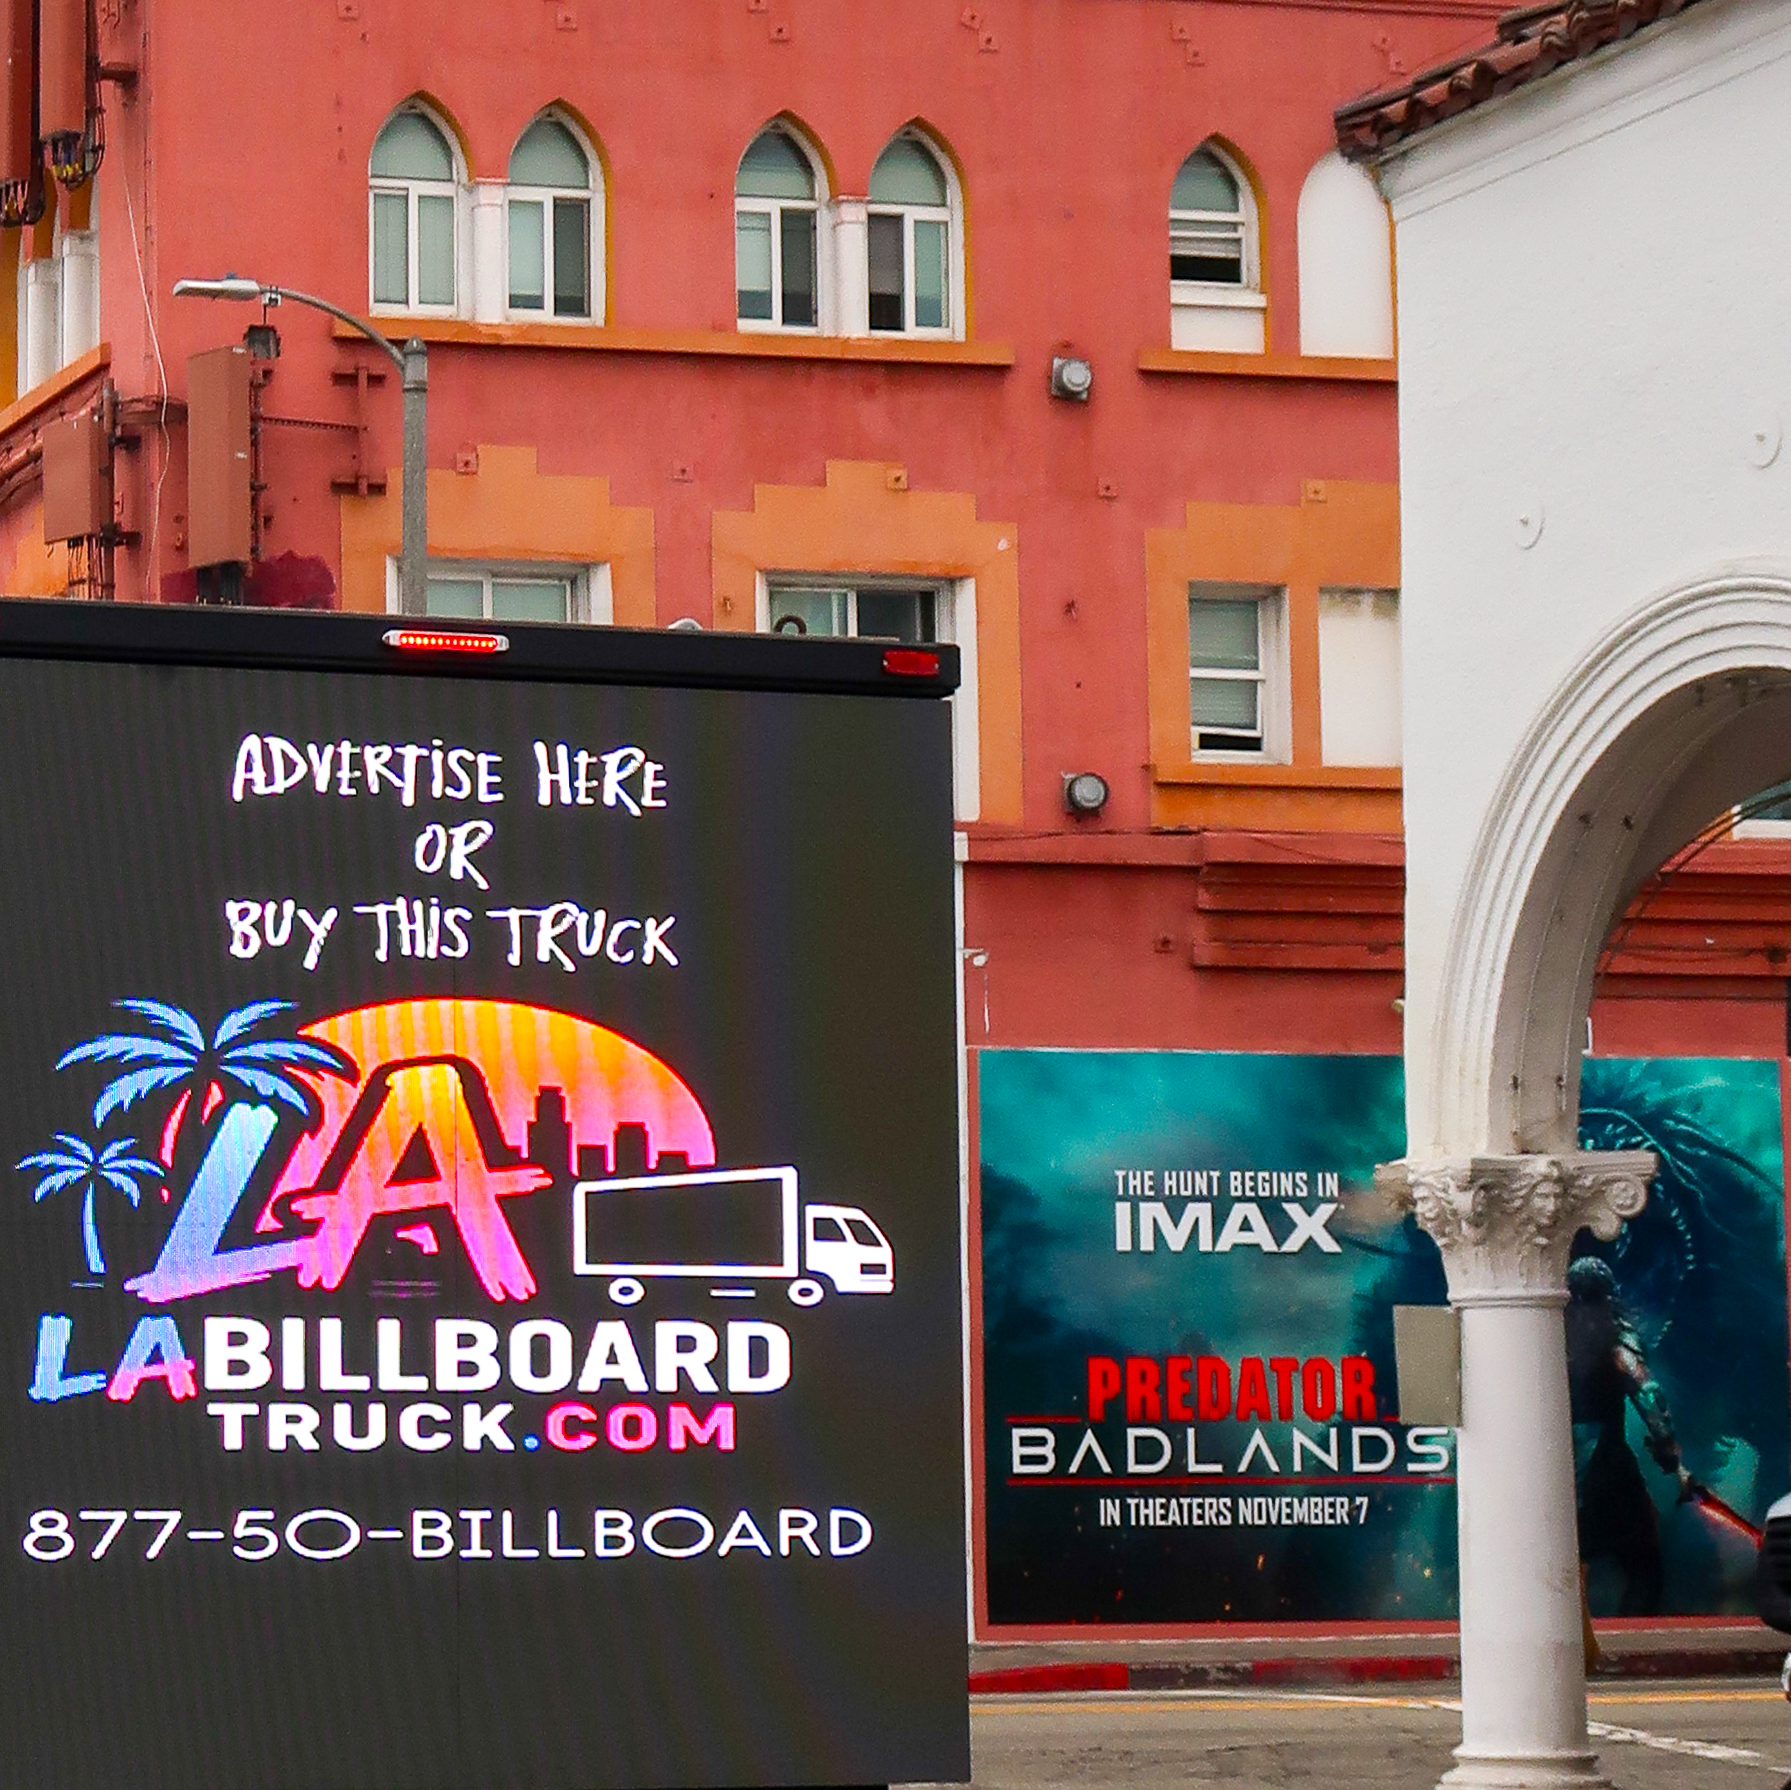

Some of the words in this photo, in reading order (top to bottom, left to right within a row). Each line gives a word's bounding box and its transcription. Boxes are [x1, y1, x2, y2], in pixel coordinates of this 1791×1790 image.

[231, 733, 505, 807] ADVERTISE
[533, 741, 667, 816] HERE
[413, 820, 493, 890] OR
[225, 899, 338, 971] BUY
[353, 896, 472, 963] THIS
[486, 902, 678, 973] TRUCK
[1115, 1170, 1155, 1197] THE
[1163, 1170, 1221, 1197] HUNT
[1229, 1170, 1308, 1197] BEGINS
[1317, 1172, 1339, 1197] IN
[1115, 1201, 1342, 1253] IMAX
[1087, 1355, 1376, 1422] PREDATOR
[207, 1402, 735, 1452] TRUCK.COM
[1011, 1426, 1449, 1474] BADLANDS
[22, 1507, 873, 1562] 877-50-BILLBOARD
[1099, 1498, 1121, 1526] IN
[1128, 1497, 1232, 1526] THEATERS
[1239, 1496, 1349, 1526] NOVEMBER
[1355, 1497, 1368, 1525] 7
